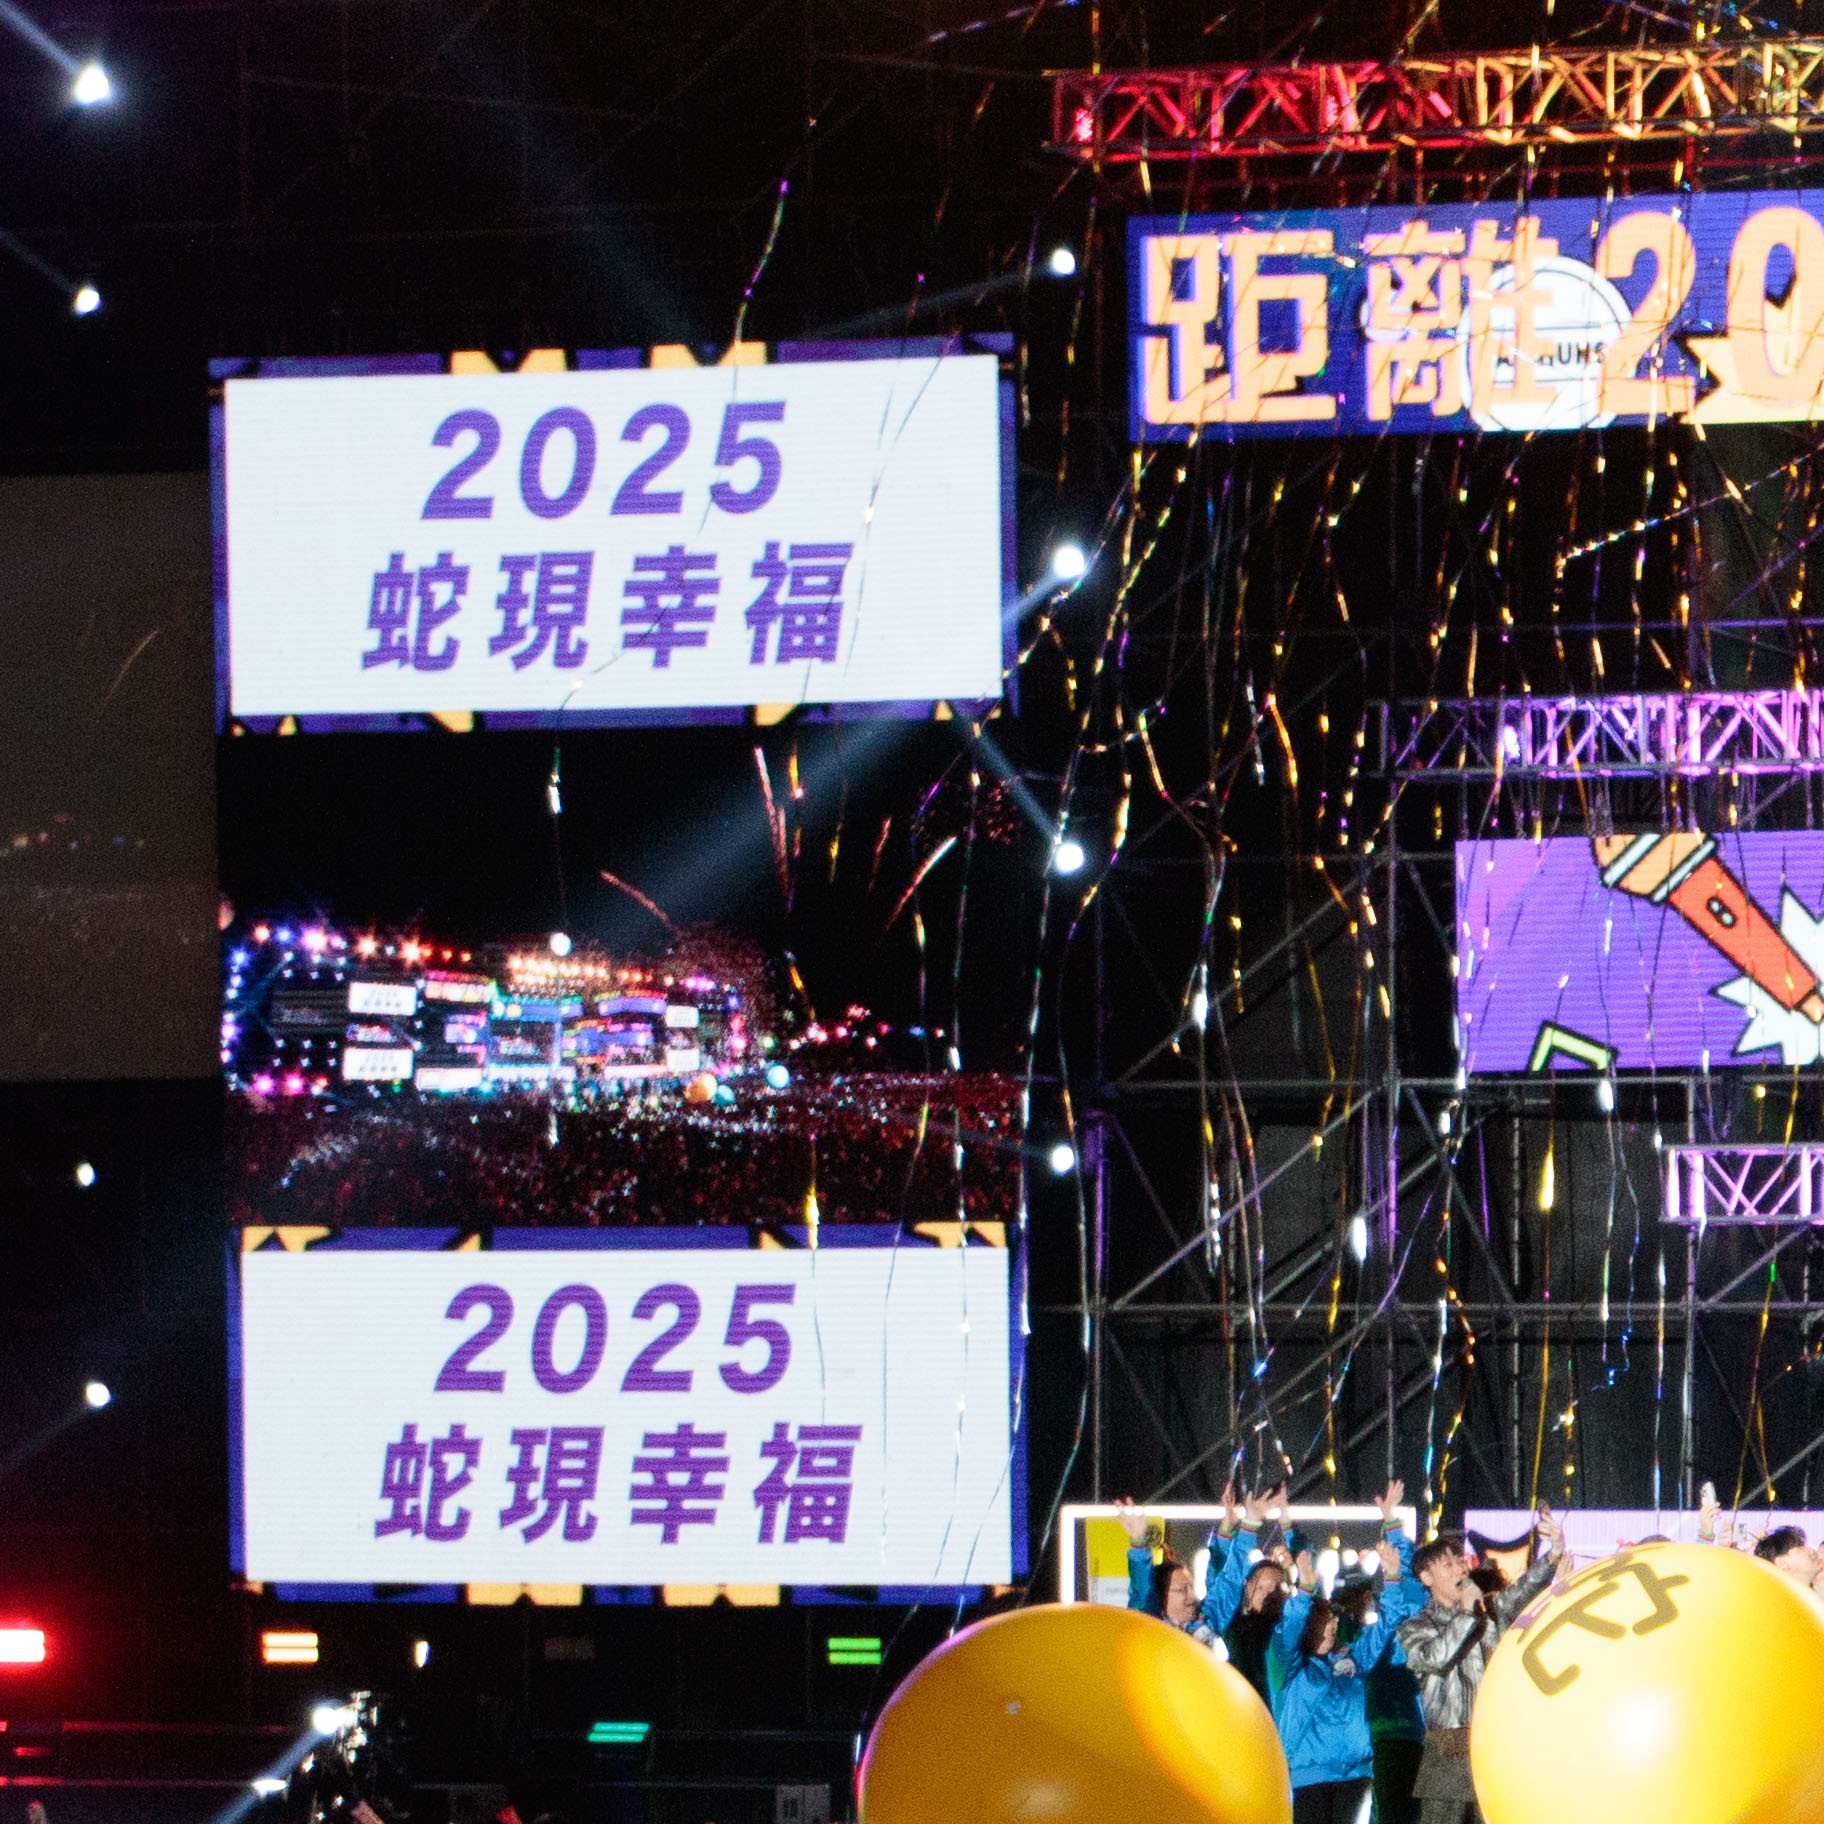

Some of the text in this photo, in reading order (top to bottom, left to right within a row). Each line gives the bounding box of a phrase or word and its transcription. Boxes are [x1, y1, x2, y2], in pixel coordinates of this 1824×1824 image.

[420, 400, 787, 521] 2025
[362, 540, 855, 673] 蛇現幸福
[434, 1282, 798, 1394] 2025
[374, 1421, 863, 1544] 蛇現幸福
